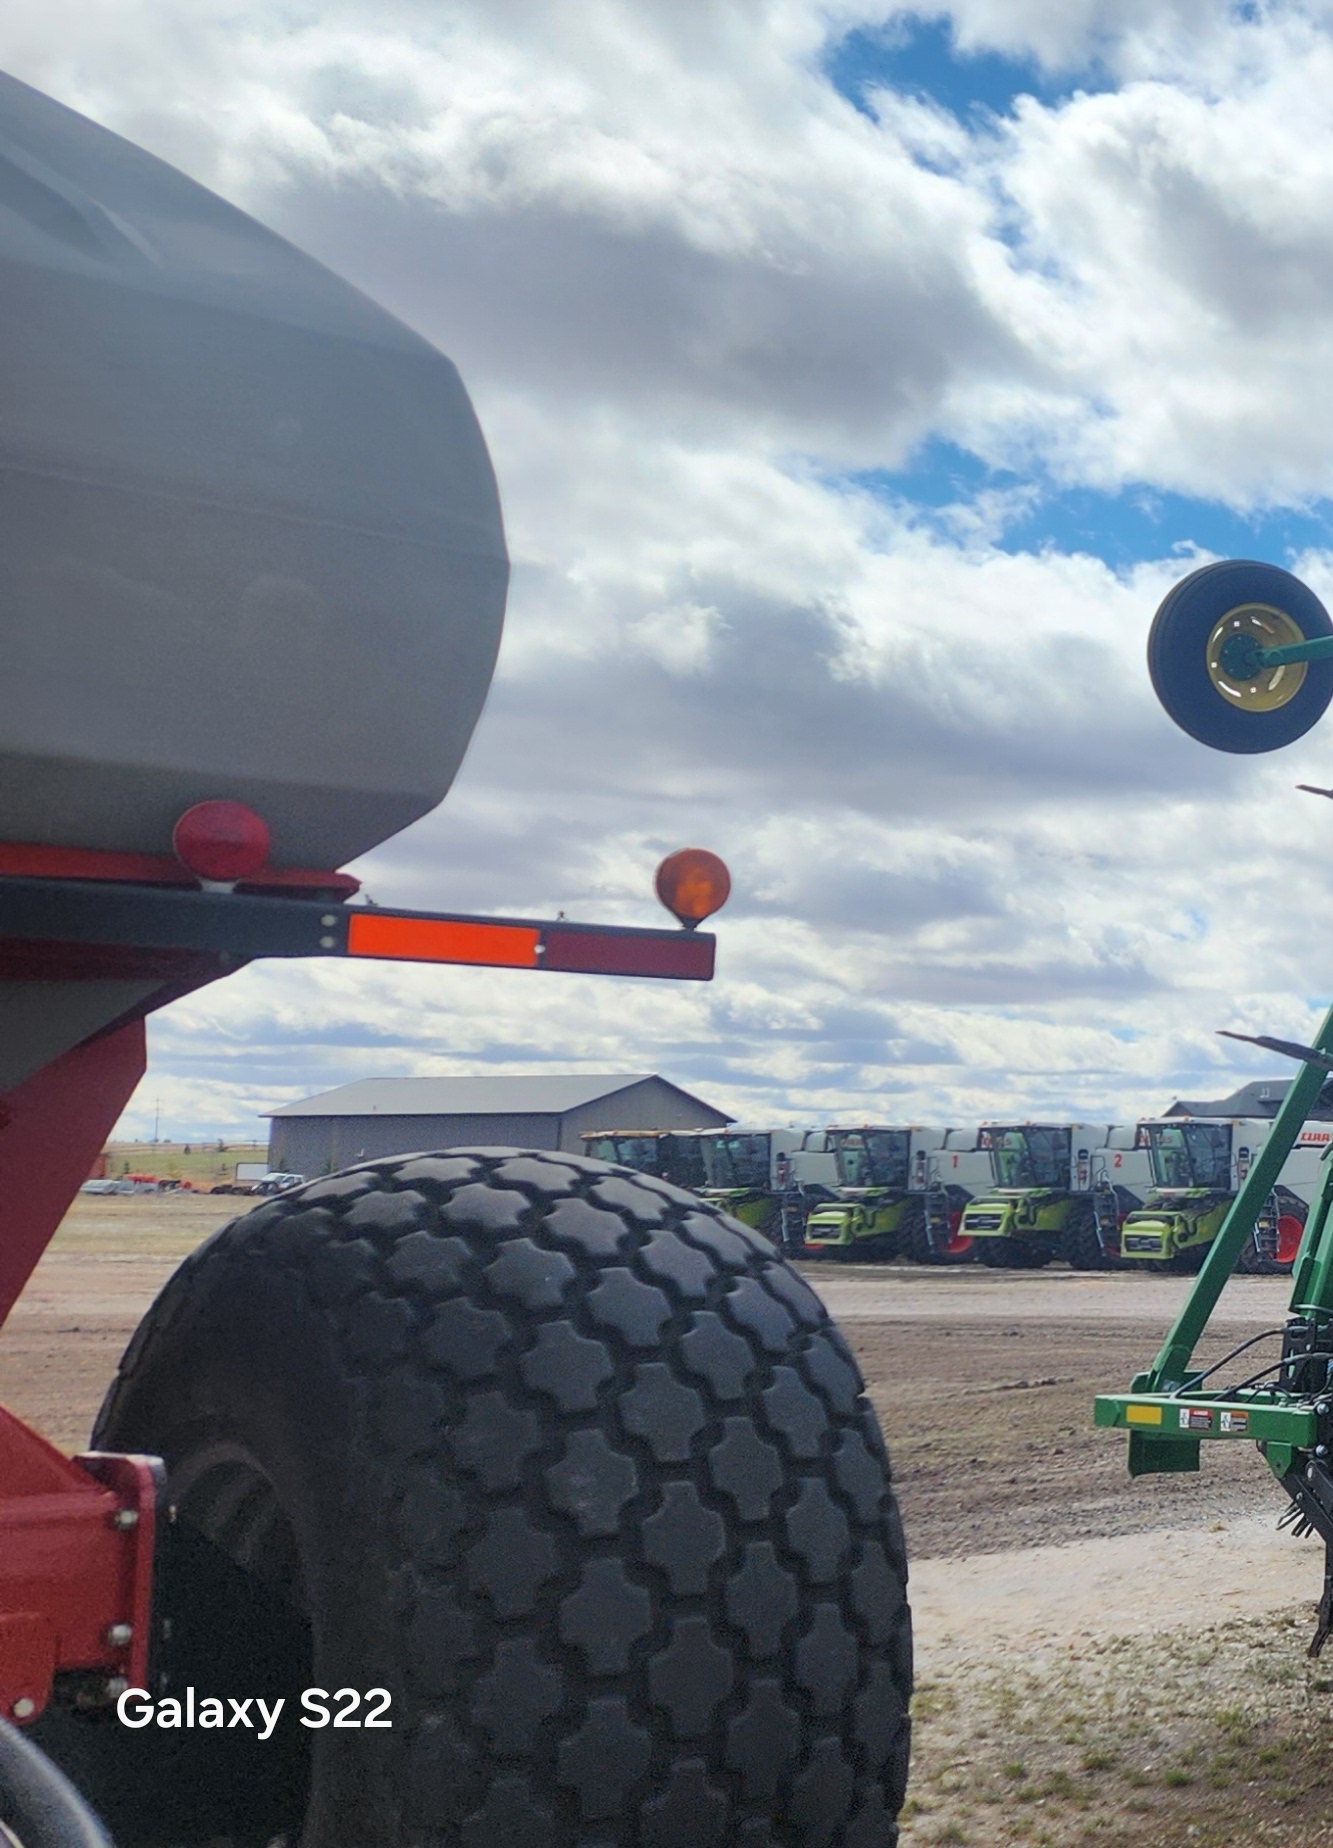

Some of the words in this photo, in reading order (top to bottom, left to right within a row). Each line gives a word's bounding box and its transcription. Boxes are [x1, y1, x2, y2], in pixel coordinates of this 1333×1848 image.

[1301, 1132, 1330, 1142] CLAA
[952, 1155, 959, 1168] 1
[1114, 1153, 1123, 1168] 2
